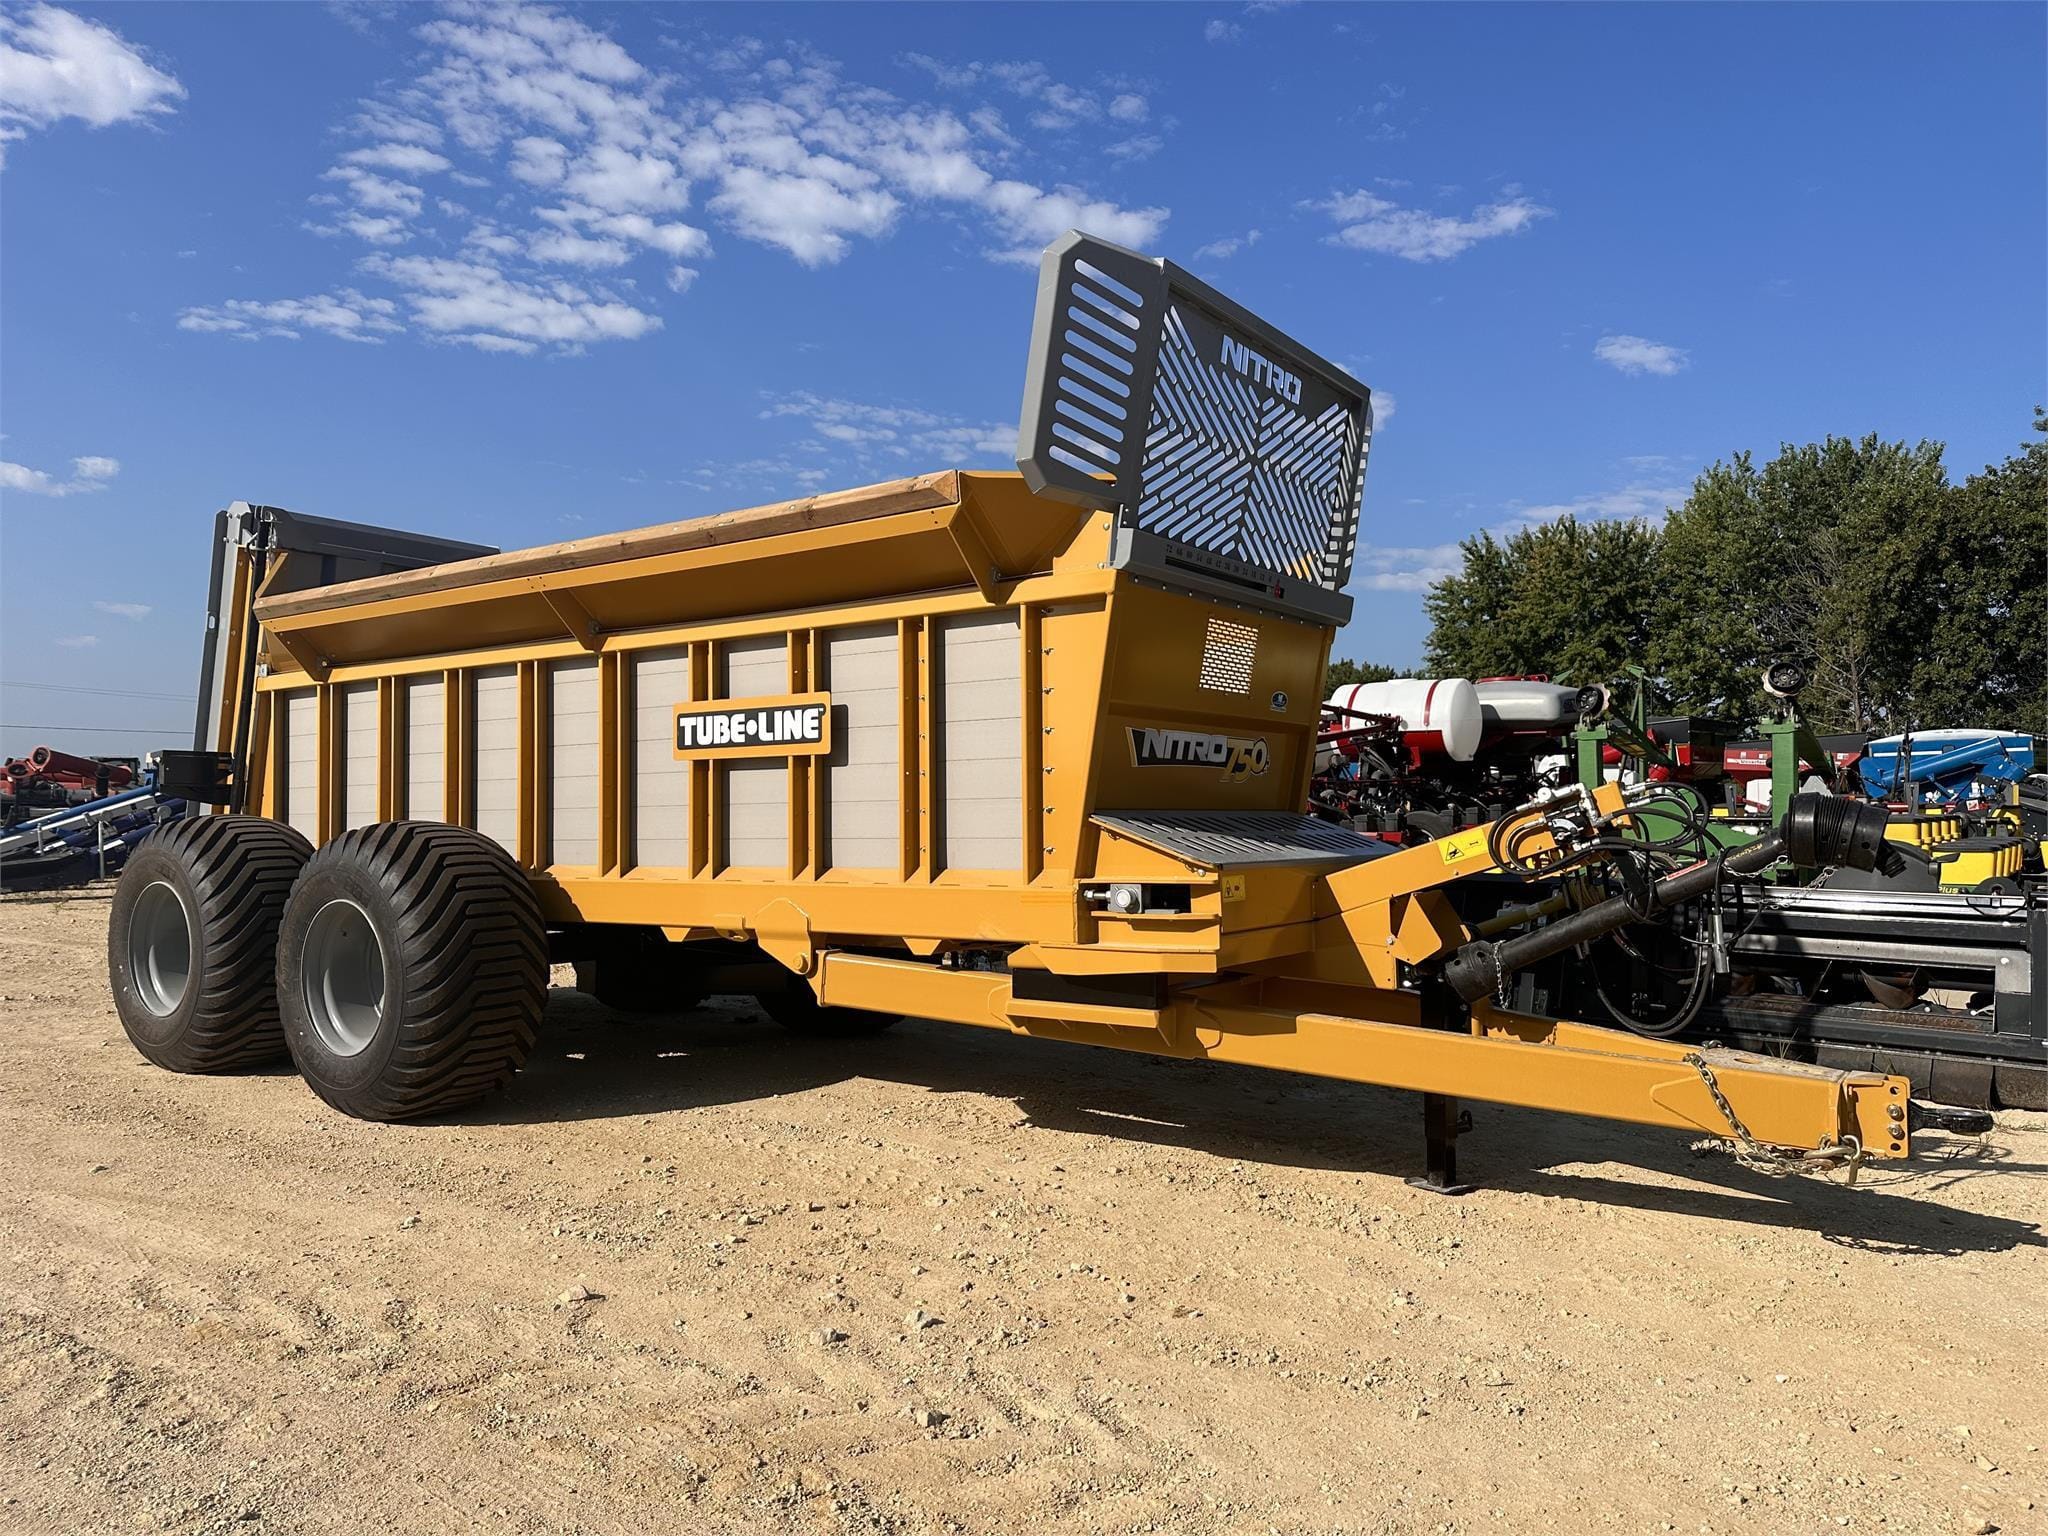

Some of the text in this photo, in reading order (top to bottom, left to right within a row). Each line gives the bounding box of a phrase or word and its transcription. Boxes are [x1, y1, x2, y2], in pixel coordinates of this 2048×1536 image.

[1220, 334, 1302, 405] NITRO
[1141, 727, 1269, 783] NITRO 750
